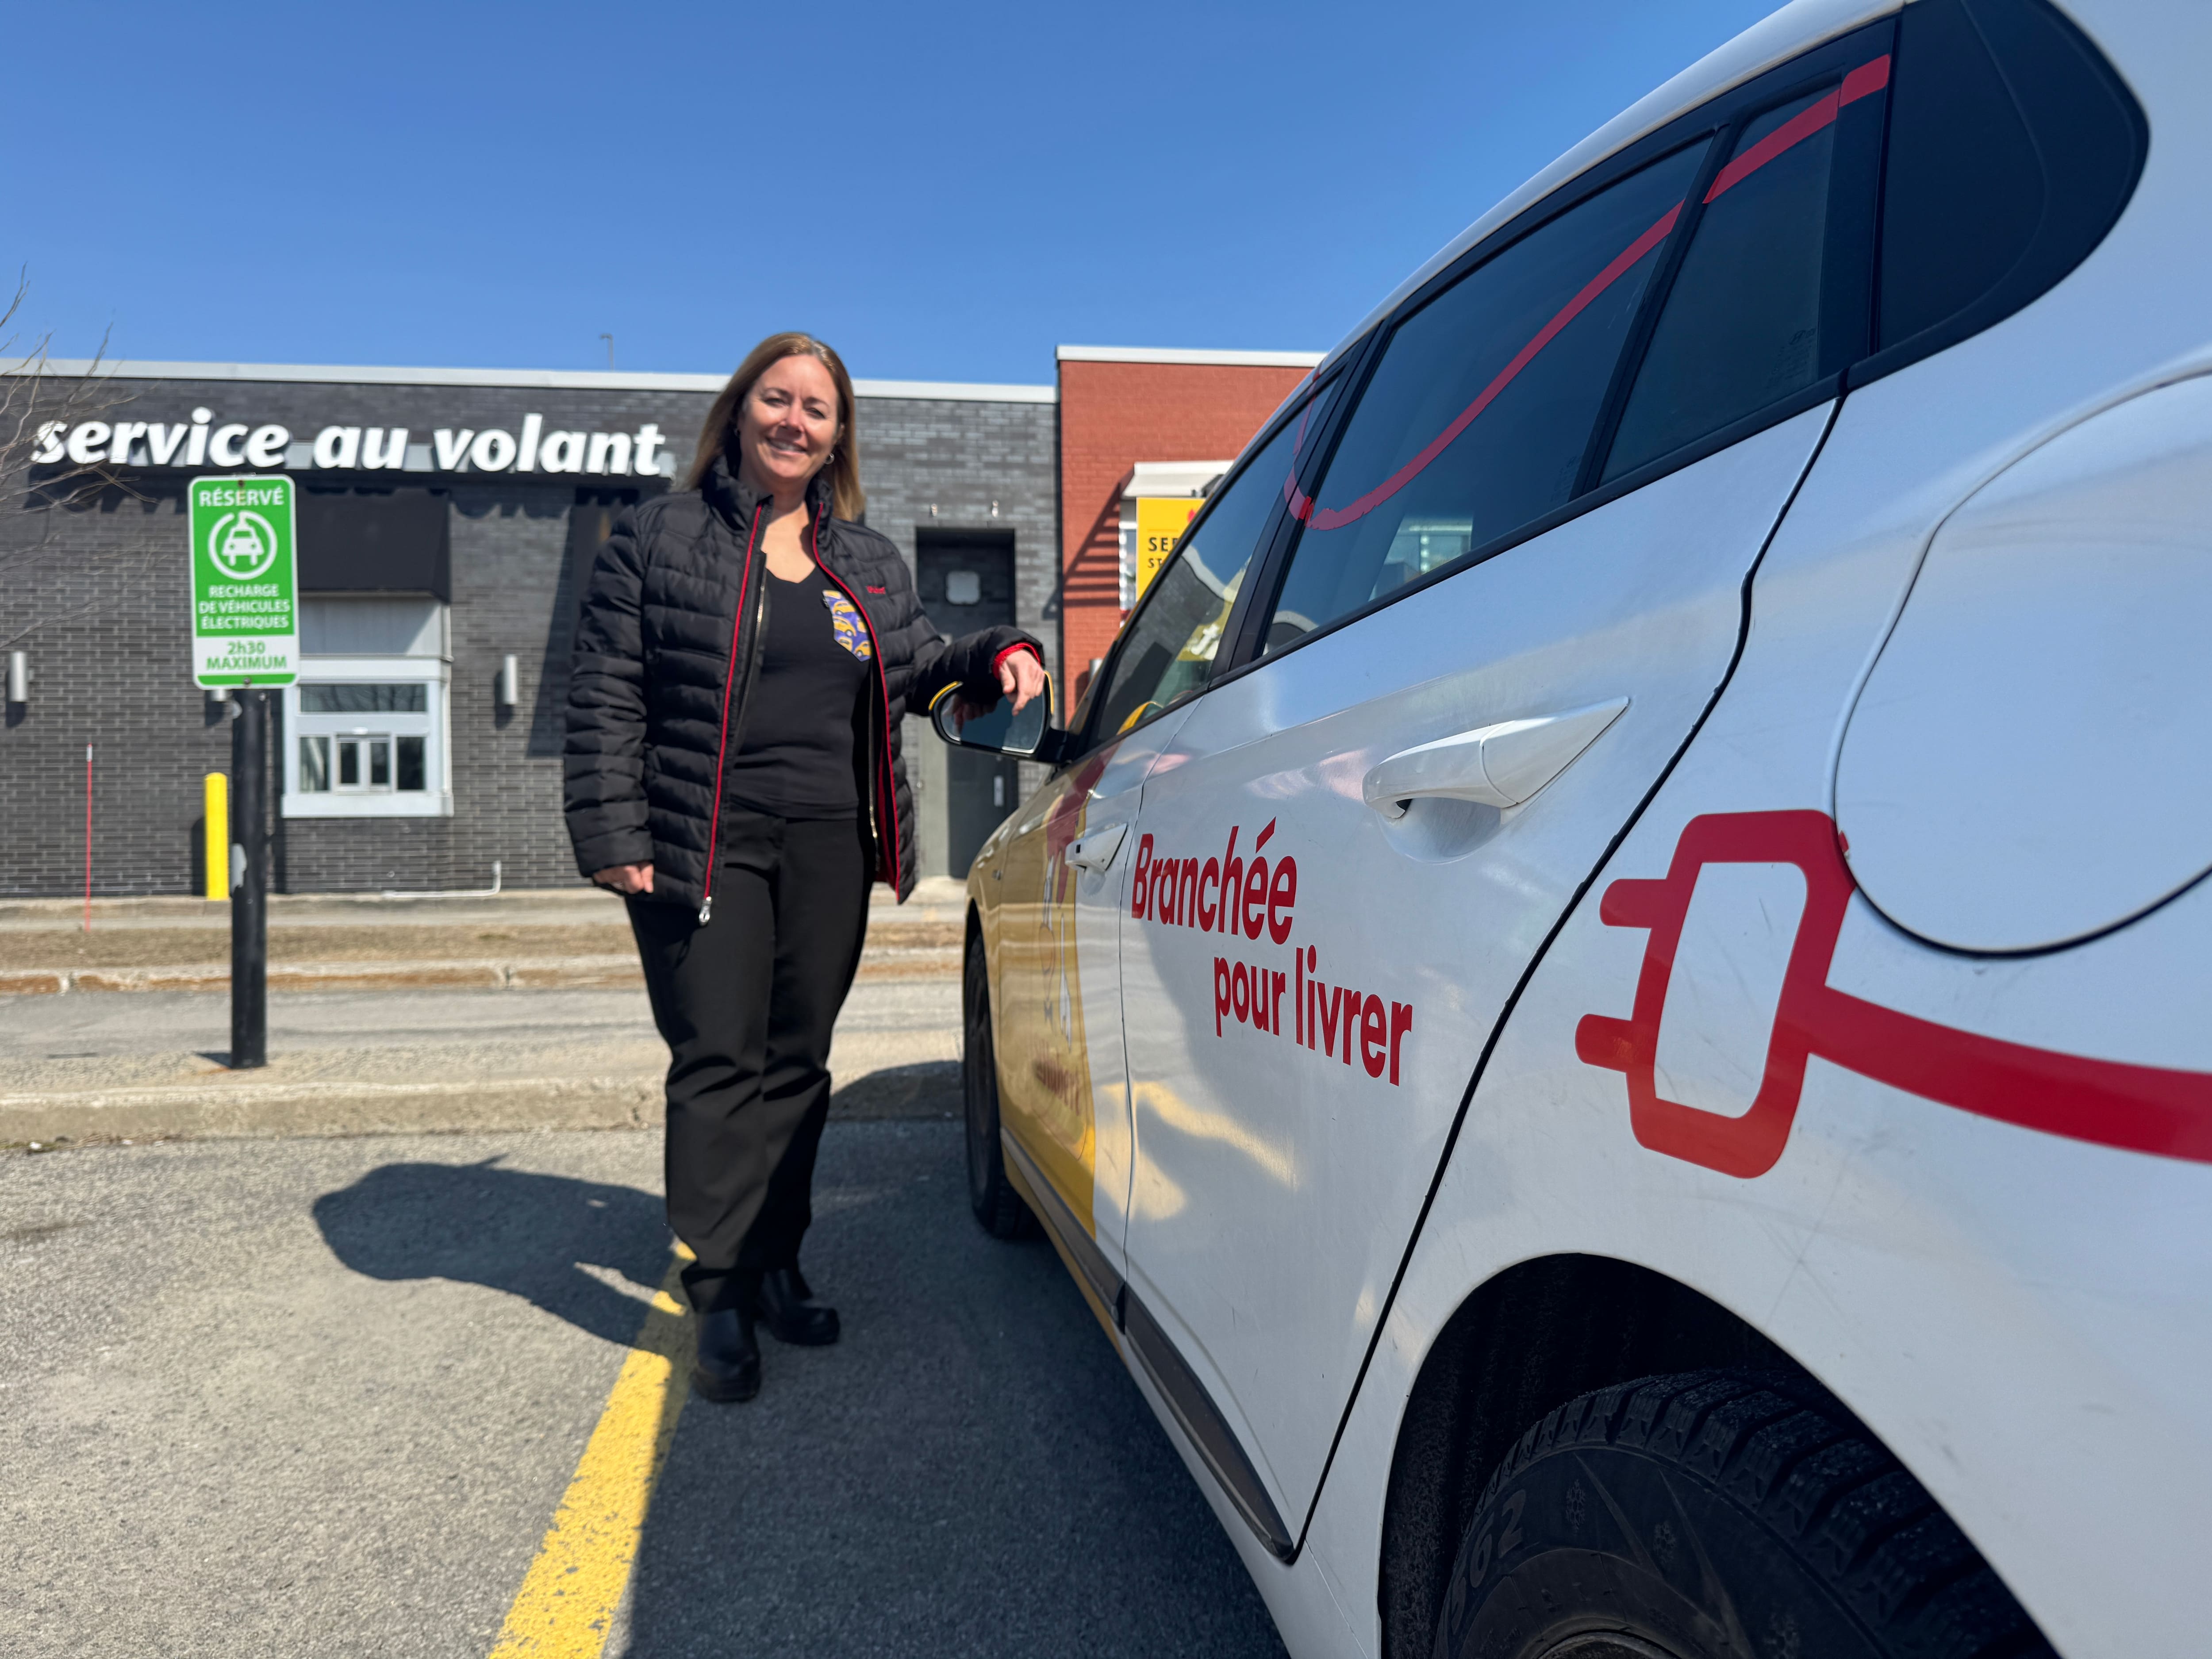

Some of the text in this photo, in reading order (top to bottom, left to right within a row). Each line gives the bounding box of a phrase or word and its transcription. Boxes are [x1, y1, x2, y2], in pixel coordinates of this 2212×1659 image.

[31, 406, 665, 476] service au volant
[199, 486, 284, 507] RÉSERVÉ
[208, 583, 280, 598] RECHARGE
[199, 599, 291, 614] DE VÉHICULES
[201, 614, 289, 630] ÉLECTRIQUES
[227, 640, 266, 655] 2h30
[206, 655, 287, 670] MAXIMUM
[1131, 816, 1297, 945] Branchée
[1214, 945, 1413, 1087] pour livrer
